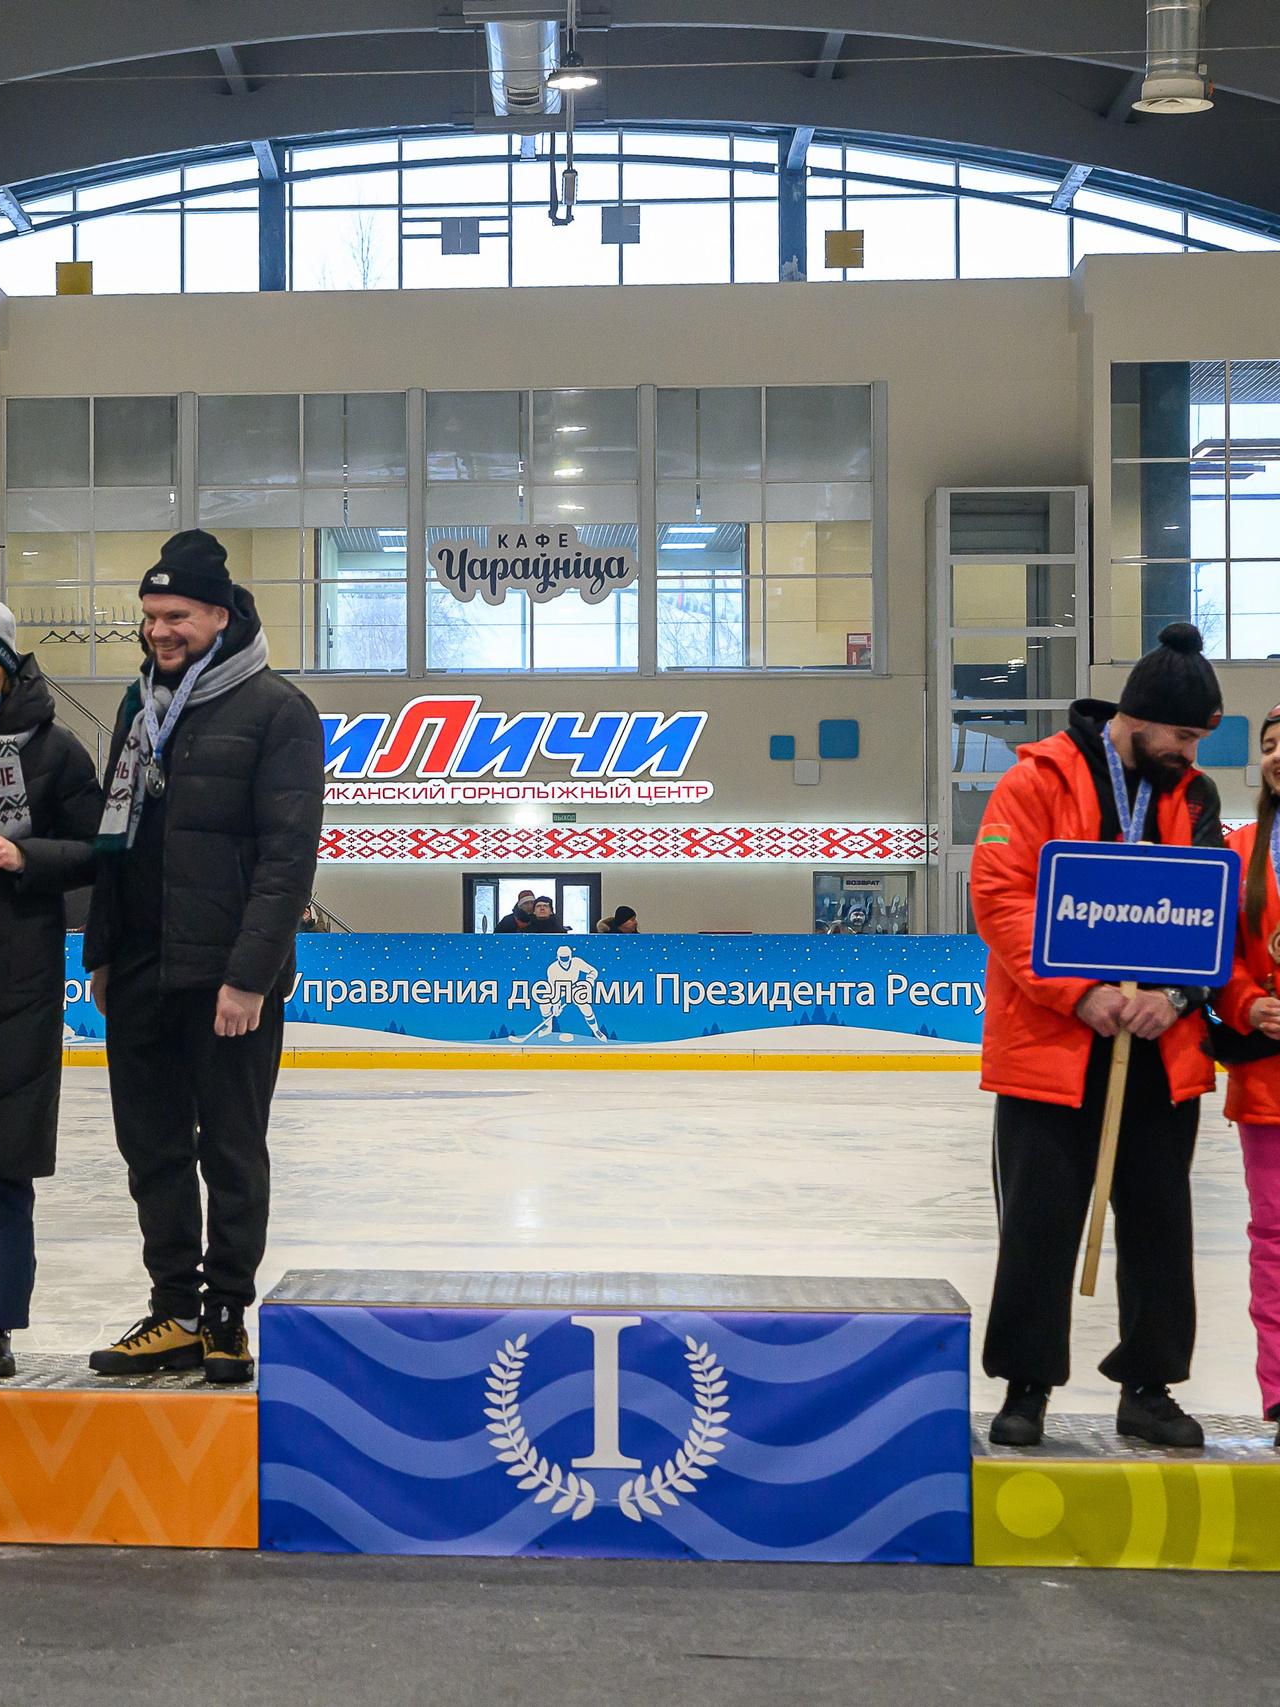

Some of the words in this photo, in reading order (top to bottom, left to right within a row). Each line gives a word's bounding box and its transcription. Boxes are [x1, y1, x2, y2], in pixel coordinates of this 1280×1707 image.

[497, 533, 569, 549] КАФЕ
[437, 548, 629, 596] Чараўніца
[450, 782, 632, 800] ГОРНОЛЫЖНЫЙ
[637, 786, 709, 804] ЦЕНТР
[1056, 894, 1215, 929] Агрохолдинг
[508, 975, 644, 1009] делами
[654, 973, 876, 1013] Президента
[571, 1315, 642, 1469] I
